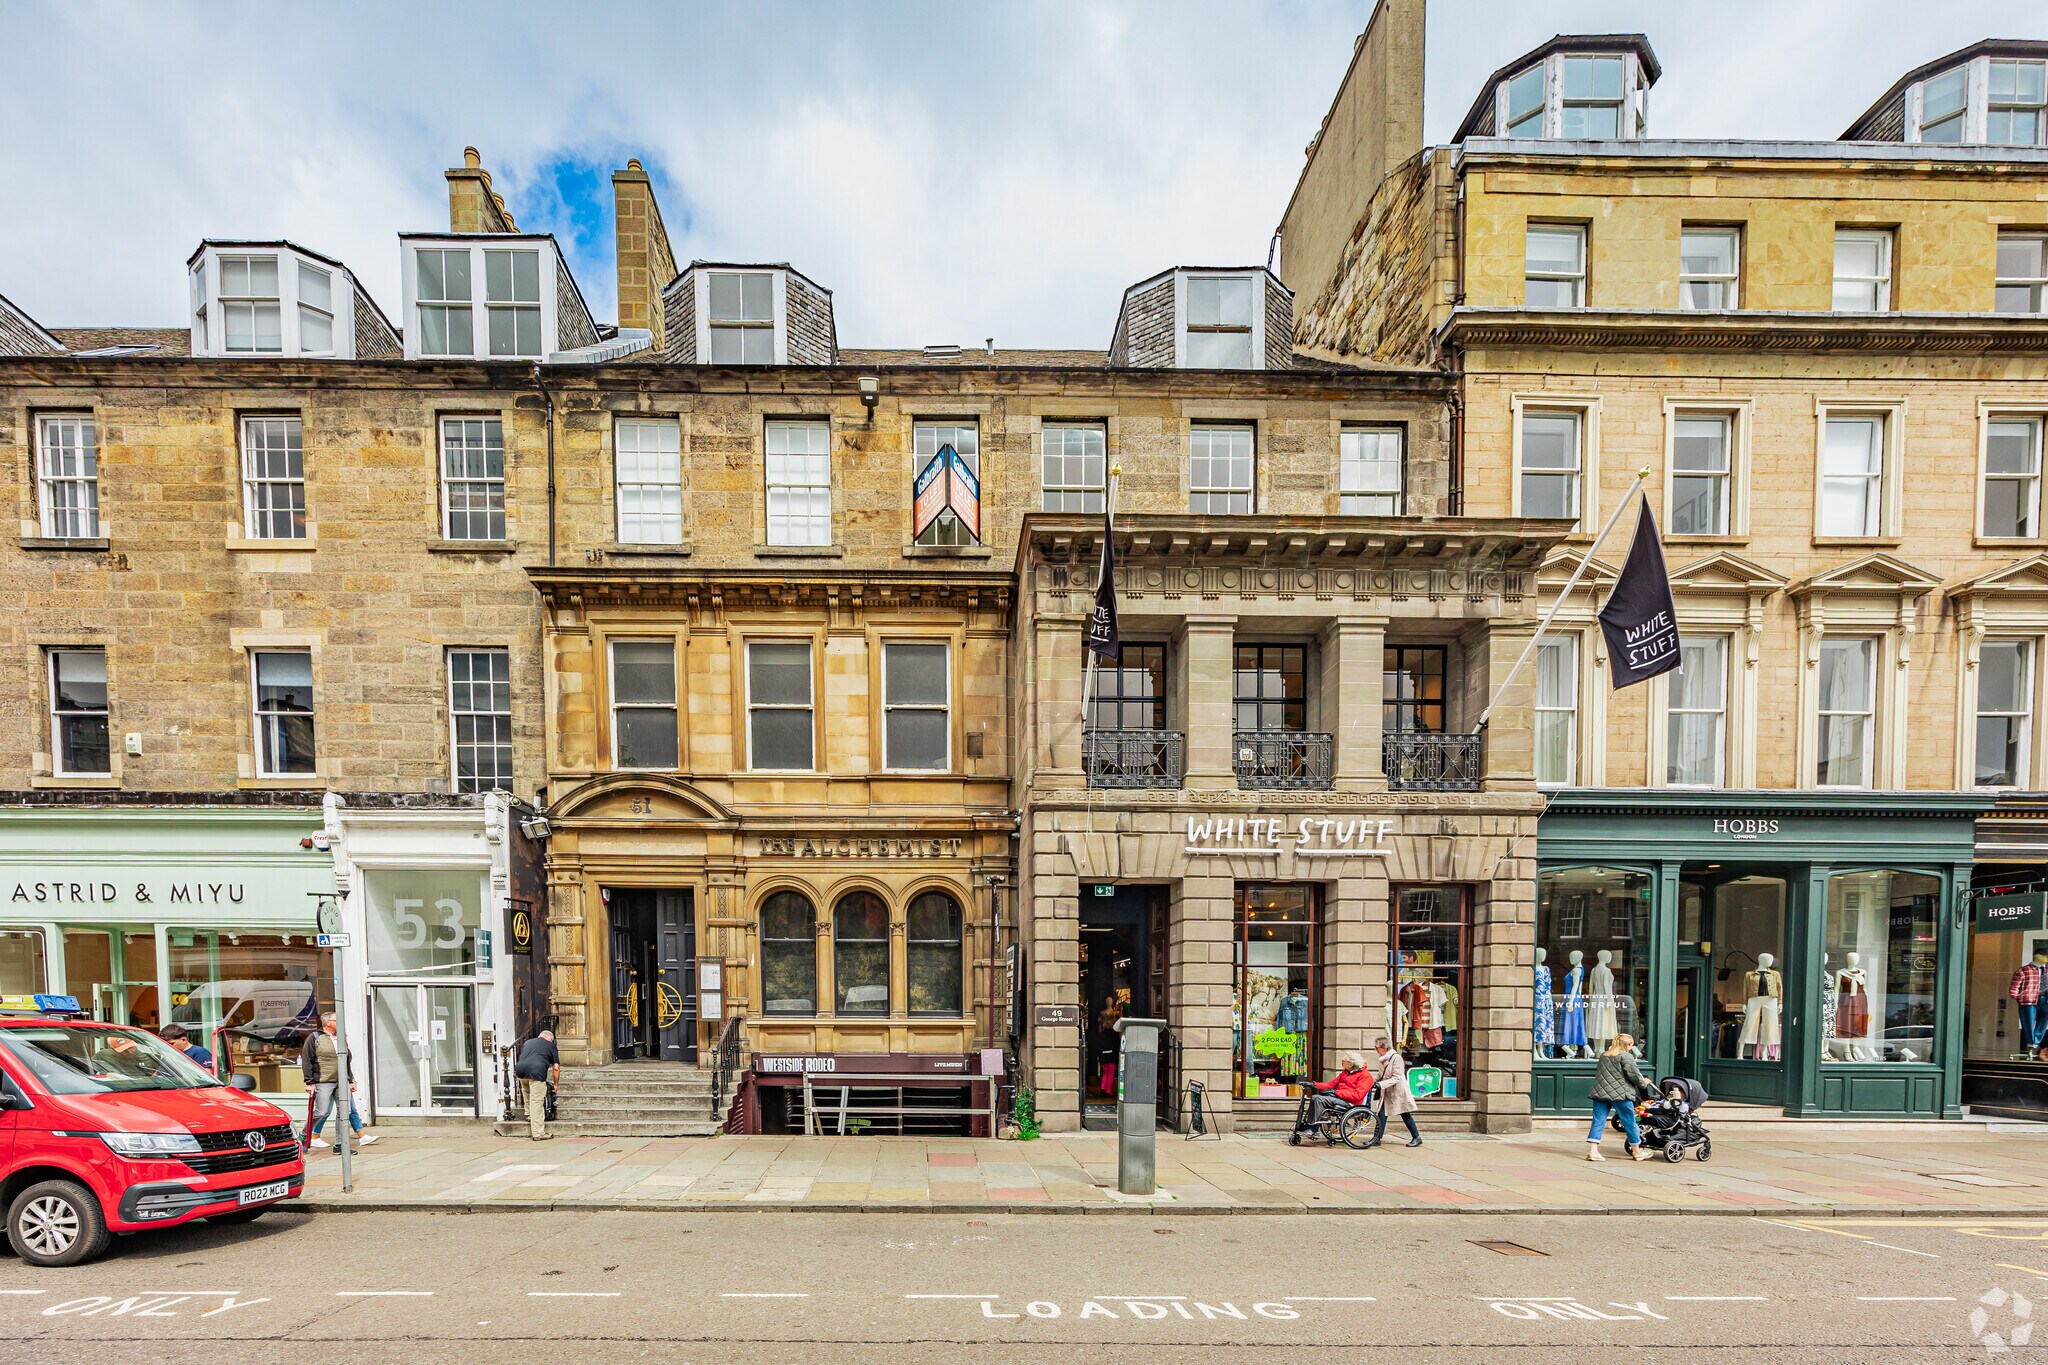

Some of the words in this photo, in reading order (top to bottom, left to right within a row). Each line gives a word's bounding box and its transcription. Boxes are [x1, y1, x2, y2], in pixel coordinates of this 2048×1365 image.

[920, 494, 929, 510] TO
[930, 477, 942, 497] LET
[955, 480, 964, 497] TO
[965, 491, 975, 510] LET
[1094, 605, 1109, 620] ITE
[1091, 624, 1111, 637] UFF
[1624, 610, 1671, 643] WHITE
[1628, 632, 1676, 666] STUFF
[629, 797, 652, 814] 51
[1187, 815, 1284, 844] WHITE
[1296, 817, 1394, 845] STUFF
[1712, 819, 1779, 834] HOBBS
[759, 837, 796, 854] THE
[800, 837, 962, 857] ALCHEMIST
[11, 882, 118, 903] ASTRID
[135, 882, 153, 904] &
[170, 882, 245, 904] MIYU
[1988, 905, 2032, 918] HOBBS
[394, 898, 466, 950] 53
[1052, 1009, 1063, 1017] 49
[1555, 1001, 1628, 1009] WONDERFUL
[762, 1057, 804, 1072] WESTSIDE
[805, 1057, 836, 1072] RODEO
[244, 1187, 268, 1202] RO22
[269, 1183, 286, 1197] MCG
[41, 1296, 272, 1318] ONLY
[980, 1299, 1301, 1320] LOADING
[1490, 1301, 1670, 1321] ONLY
